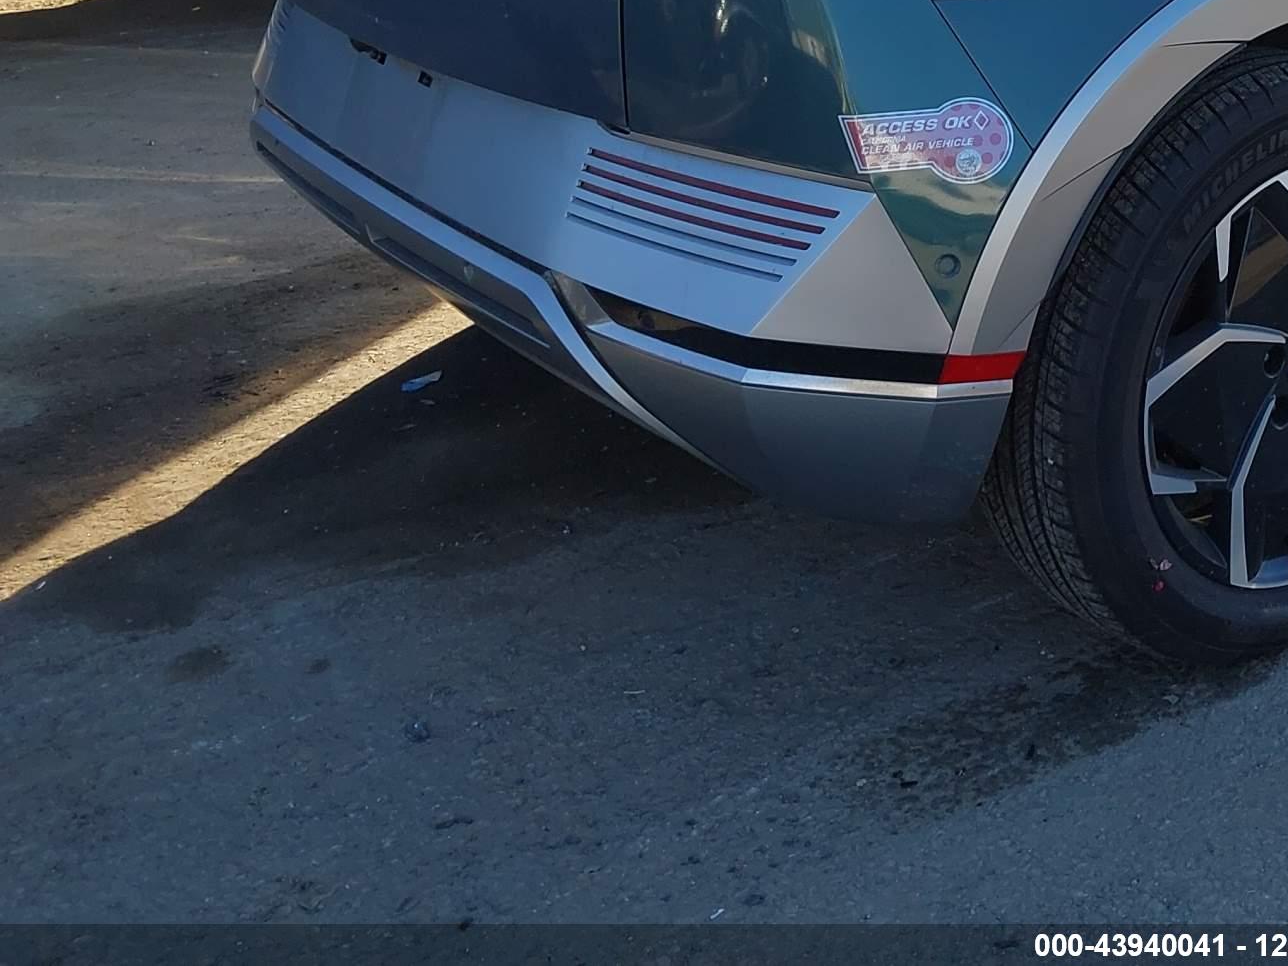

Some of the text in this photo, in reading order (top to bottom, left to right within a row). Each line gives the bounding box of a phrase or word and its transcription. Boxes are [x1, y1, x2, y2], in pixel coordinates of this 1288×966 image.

[861, 115, 972, 136] ACCESS OK
[861, 137, 974, 155] CLEAN AIR VEHICLE
